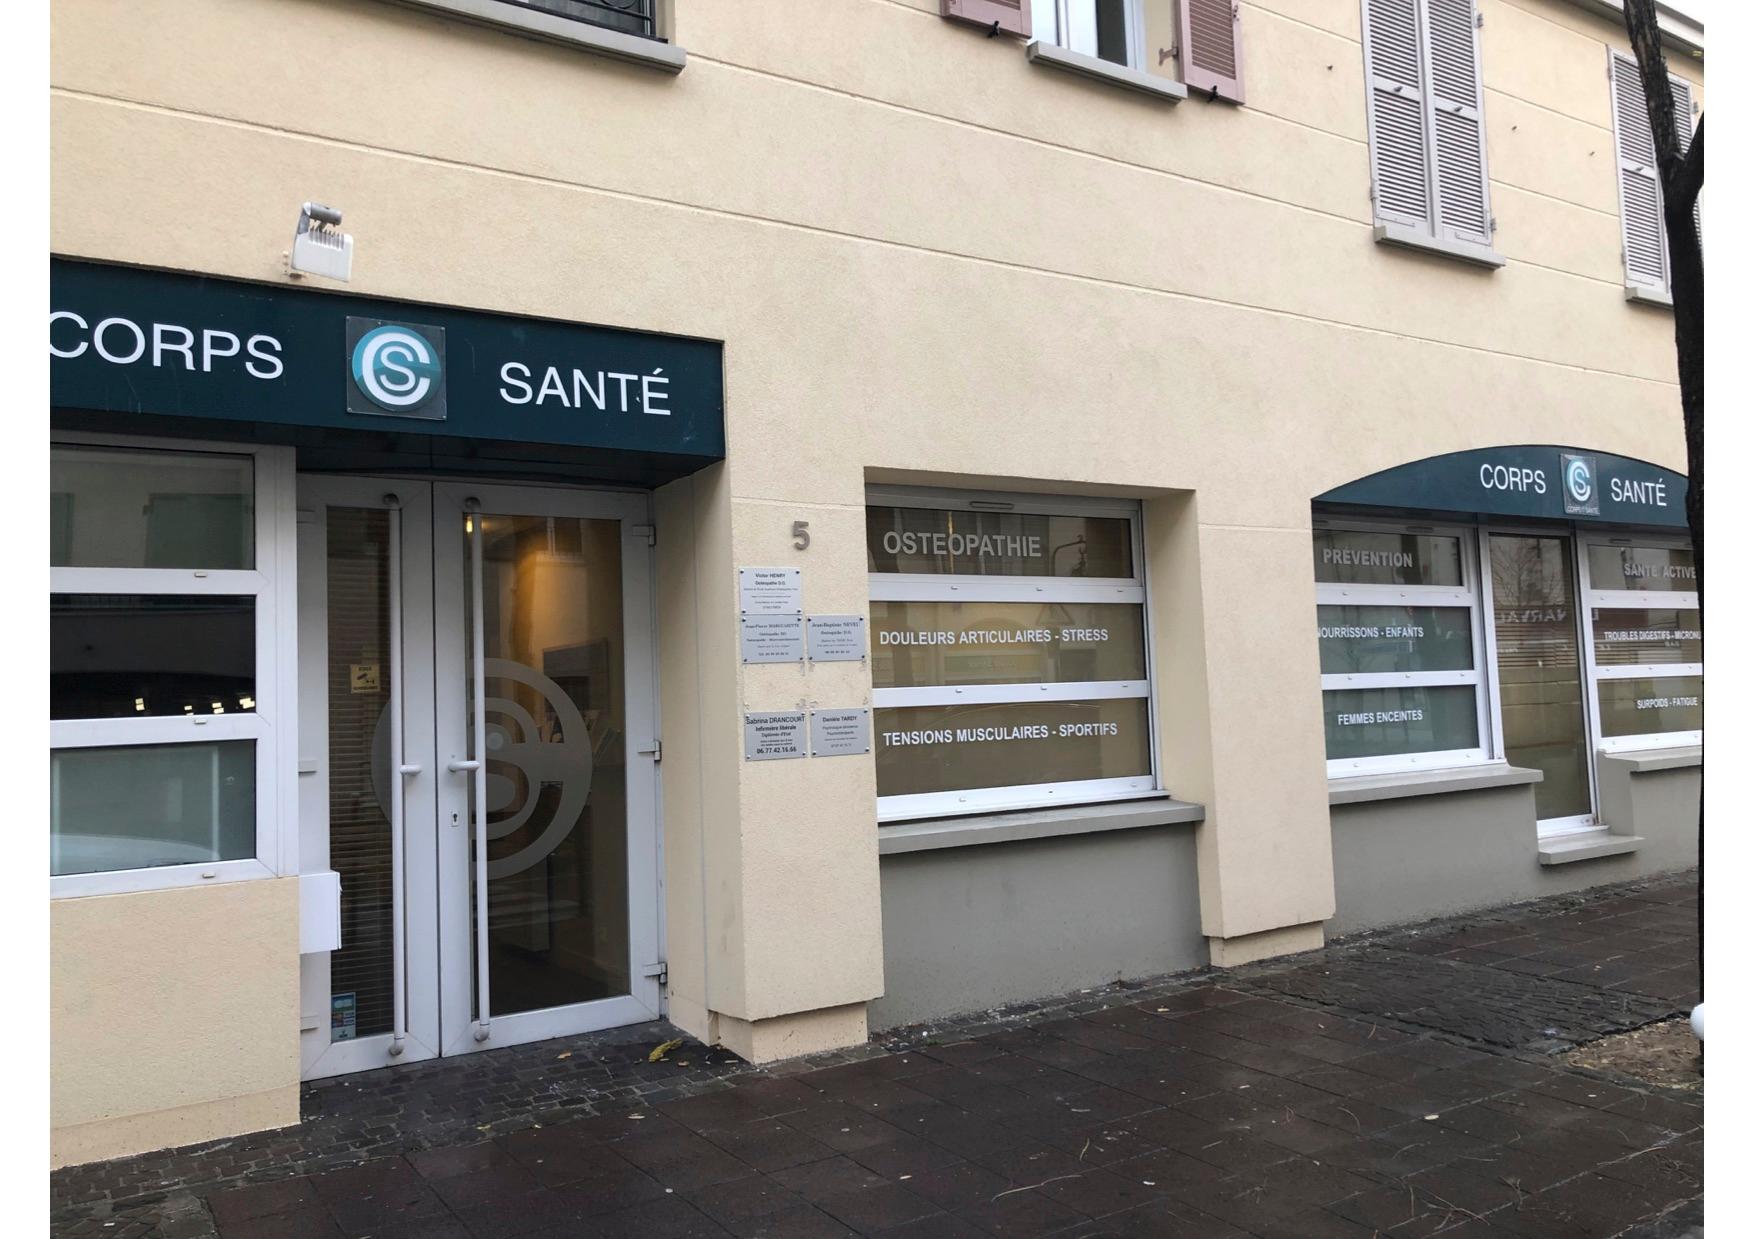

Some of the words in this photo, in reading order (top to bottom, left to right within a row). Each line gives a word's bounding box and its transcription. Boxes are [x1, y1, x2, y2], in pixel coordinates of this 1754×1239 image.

[50, 311, 284, 379] CORPS
[499, 361, 672, 416] SANTÉ
[1480, 463, 1546, 494] CORPS
[1610, 477, 1667, 506] SANTÉ
[793, 520, 810, 551] 5
[883, 531, 1042, 557] OSTEOPATHIE
[1323, 546, 1413, 568] PRÉVENTION
[1662, 565, 1697, 579] ACTIVE
[879, 630, 956, 645] DOULEURS
[959, 630, 1051, 644] ARTICULAIRES
[1062, 628, 1109, 642] STRESS
[1385, 626, 1425, 638] ENFANTS
[1604, 631, 1638, 641] TROUBLES
[1639, 630, 1670, 641] DIGESTIFS
[1637, 697, 1669, 709] SURPOIDS
[1672, 696, 1698, 707] FATIGUE
[1338, 713, 1374, 725] FEMMES
[1376, 710, 1423, 723] ENCEINTES
[882, 730, 953, 747] TENSIONS
[956, 725, 1049, 743] MUSCULAIRES
[1059, 722, 1118, 737] SPORTIFS
